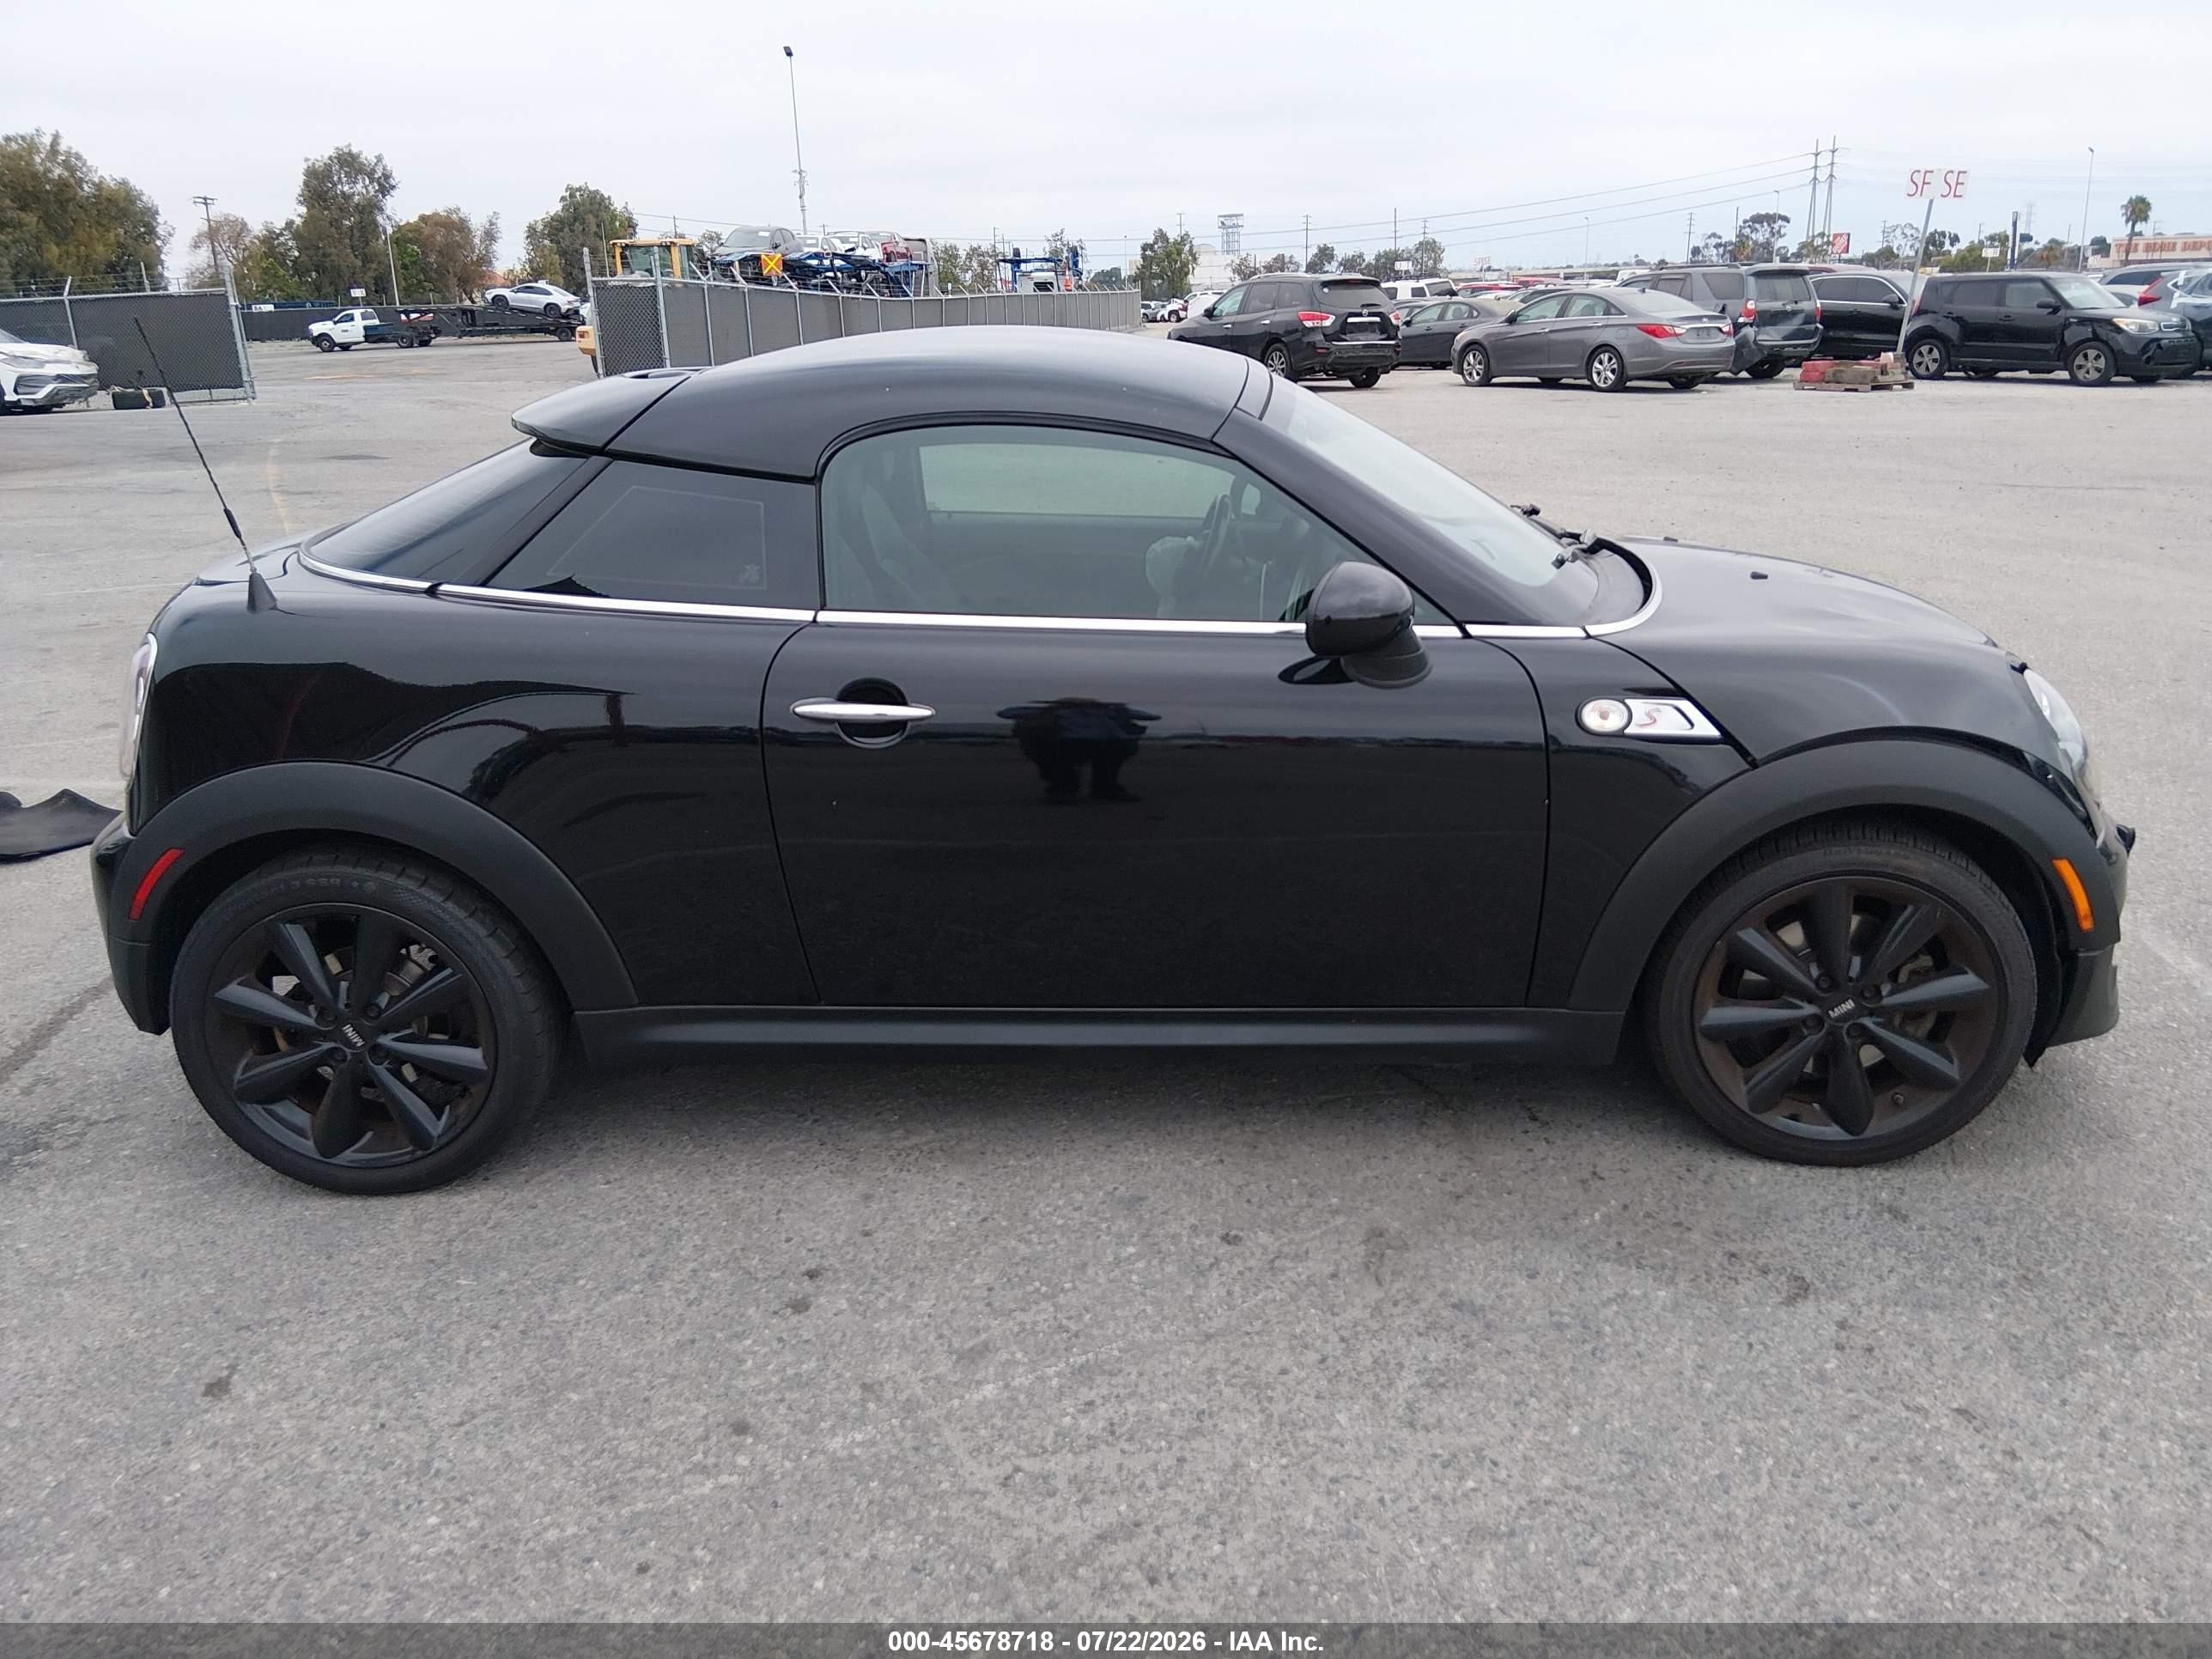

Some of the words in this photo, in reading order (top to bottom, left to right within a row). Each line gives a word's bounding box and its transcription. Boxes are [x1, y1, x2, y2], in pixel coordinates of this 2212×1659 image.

[1906, 169, 1935, 197] SF
[1940, 169, 1967, 198] SE
[1635, 708, 1662, 729] S
[1827, 999, 1855, 1018] MINI
[342, 1024, 366, 1047] MINI
